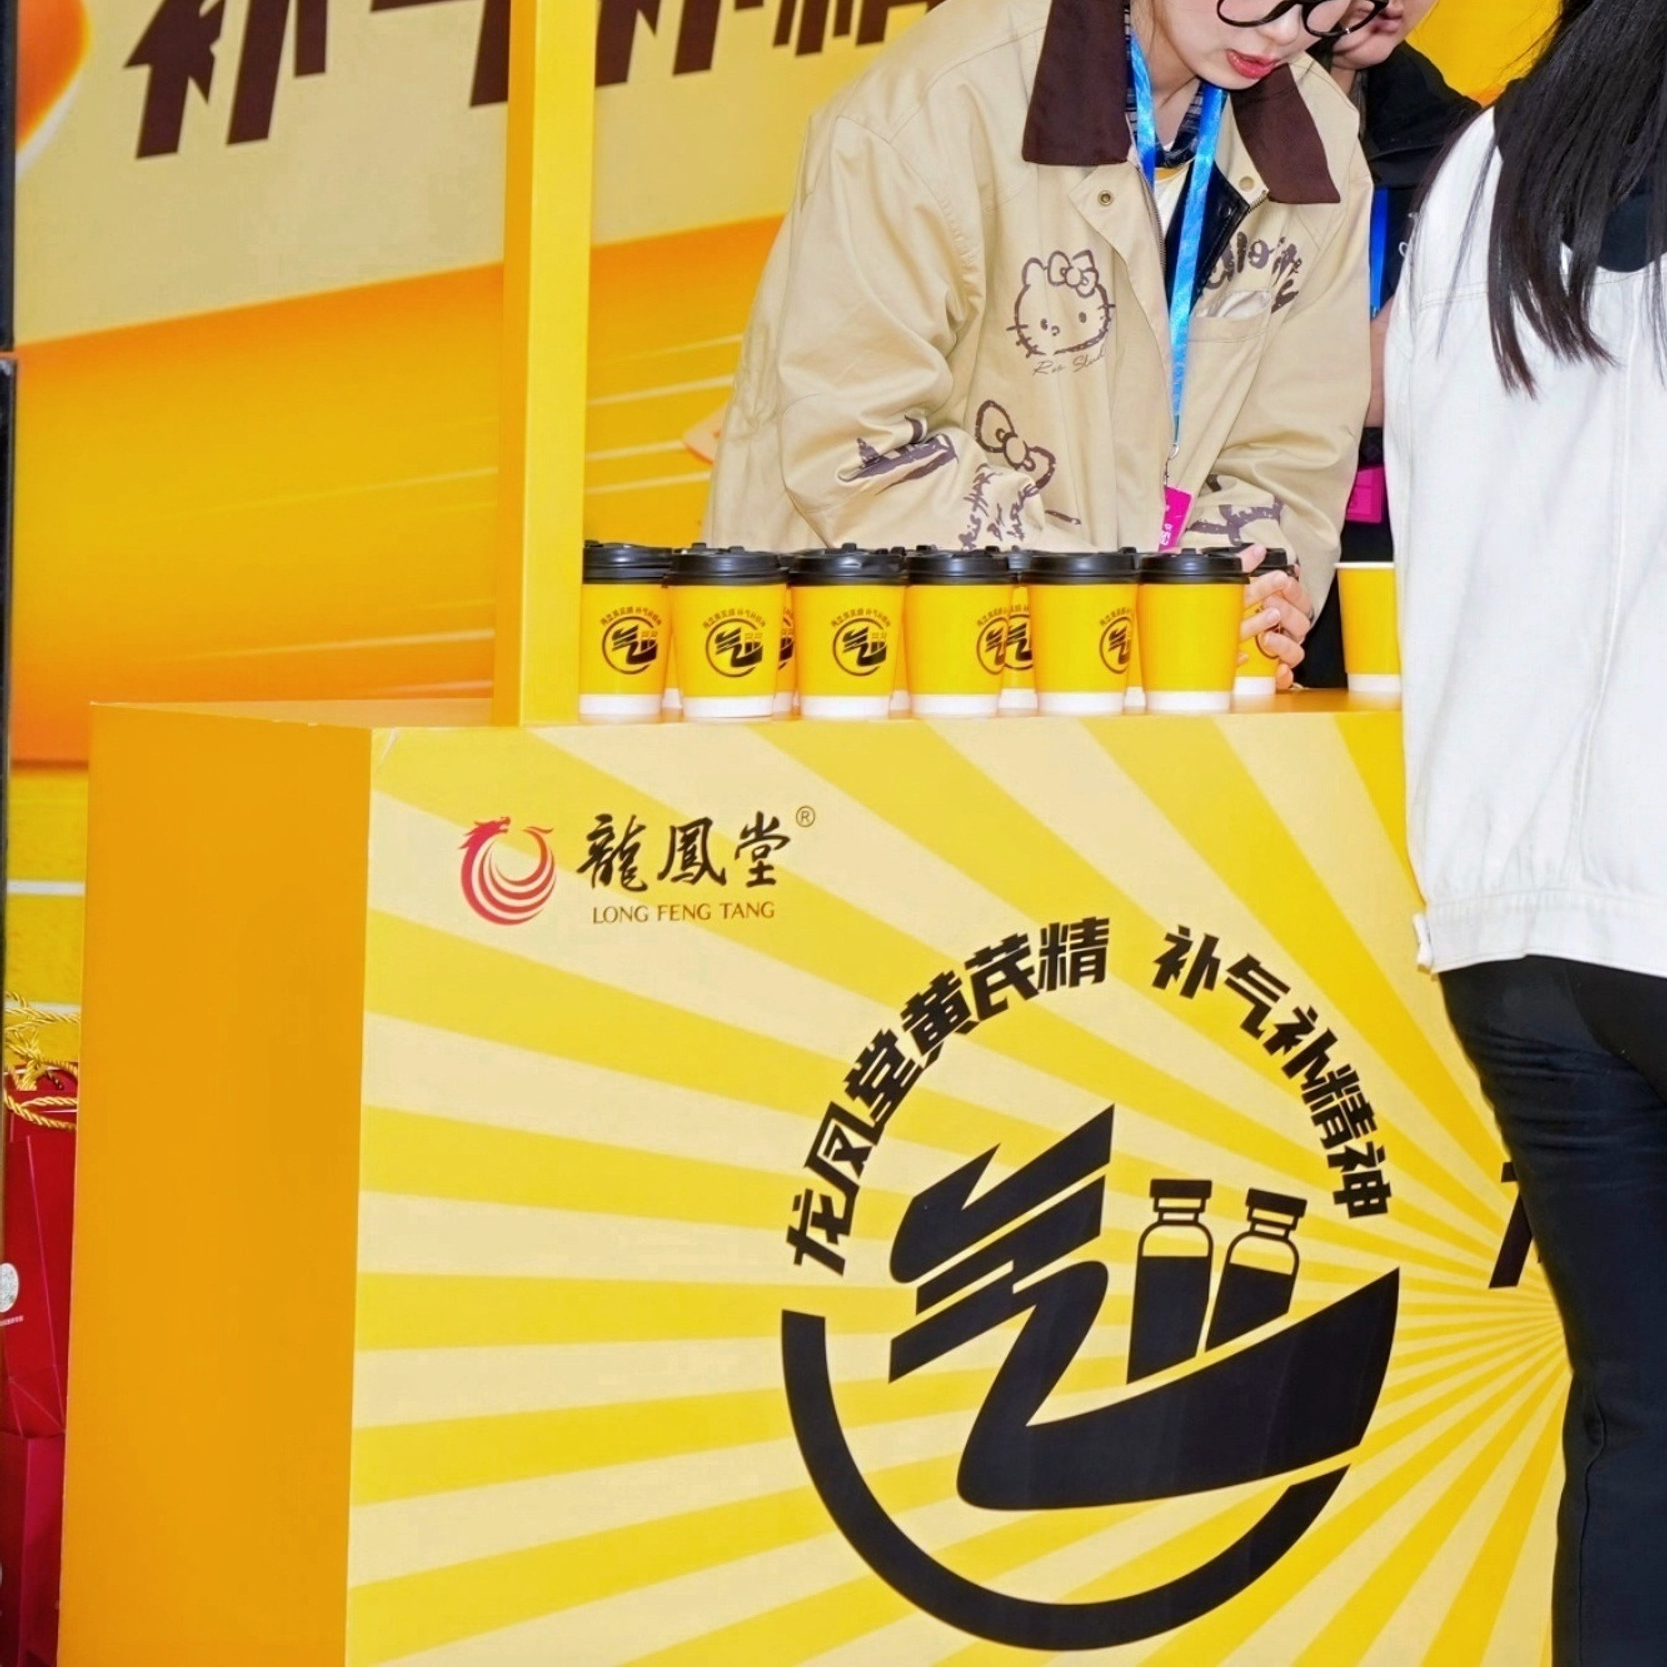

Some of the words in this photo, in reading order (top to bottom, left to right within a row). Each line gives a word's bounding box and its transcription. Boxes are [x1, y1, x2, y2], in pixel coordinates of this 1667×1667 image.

[592, 905, 650, 925] LONG
[656, 902, 713, 923] FENG
[719, 900, 776, 921] TANG
[786, 916, 1111, 1277] 龙凤堂黄芪精
[1151, 923, 1394, 1220] 补气补精神
